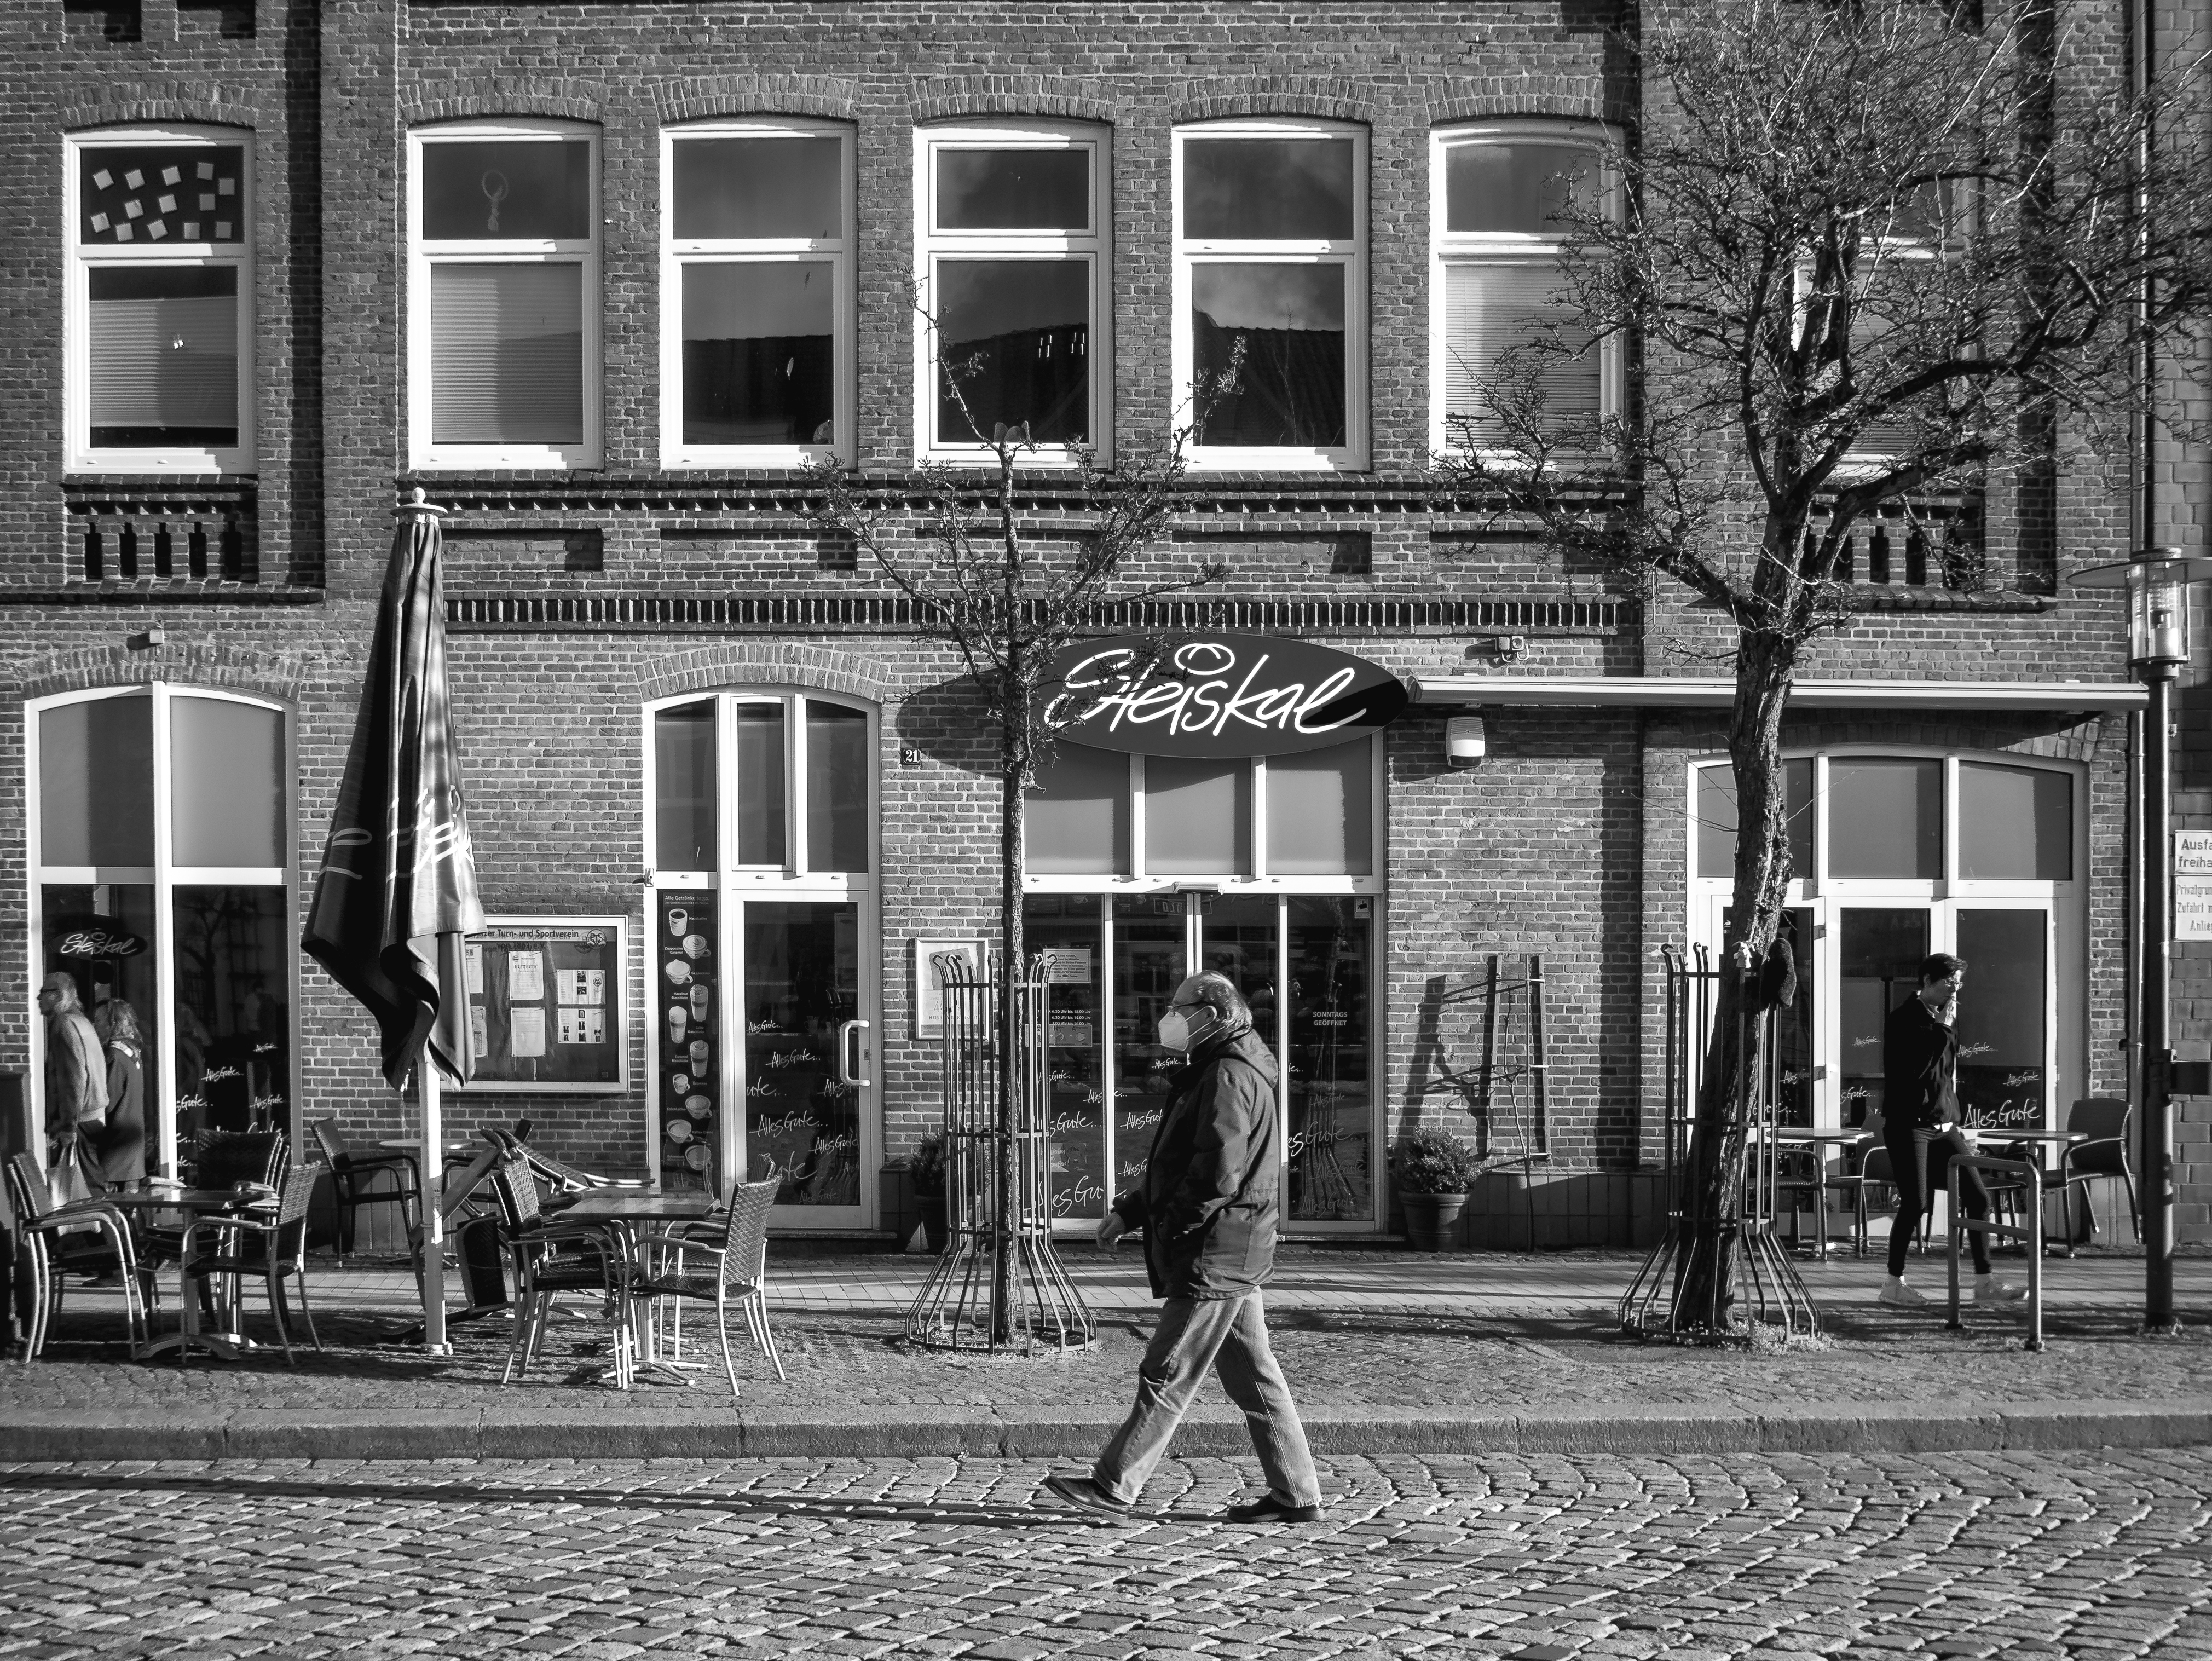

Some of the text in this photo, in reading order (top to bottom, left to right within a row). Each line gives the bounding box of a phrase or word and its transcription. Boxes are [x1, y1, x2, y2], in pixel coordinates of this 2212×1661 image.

[1044, 643, 1367, 736] Steiskal
[905, 749, 920, 763] 21
[519, 928, 534, 937] und
[536, 928, 579, 939] Sportverein
[61, 932, 138, 955] Steiskal
[747, 1022, 761, 1033] Alles
[765, 1051, 789, 1068] Alles
[1151, 1059, 1165, 1069] Alles
[746, 1076, 787, 1097] ute...
[817, 1079, 845, 1098] Alles
[1120, 1109, 1163, 1129] Alles Gut
[1956, 1104, 1997, 1128] Alles
[749, 1114, 783, 1138] Alles
[808, 1137, 834, 1155] Alles
[1118, 1161, 1141, 1176] Alles
